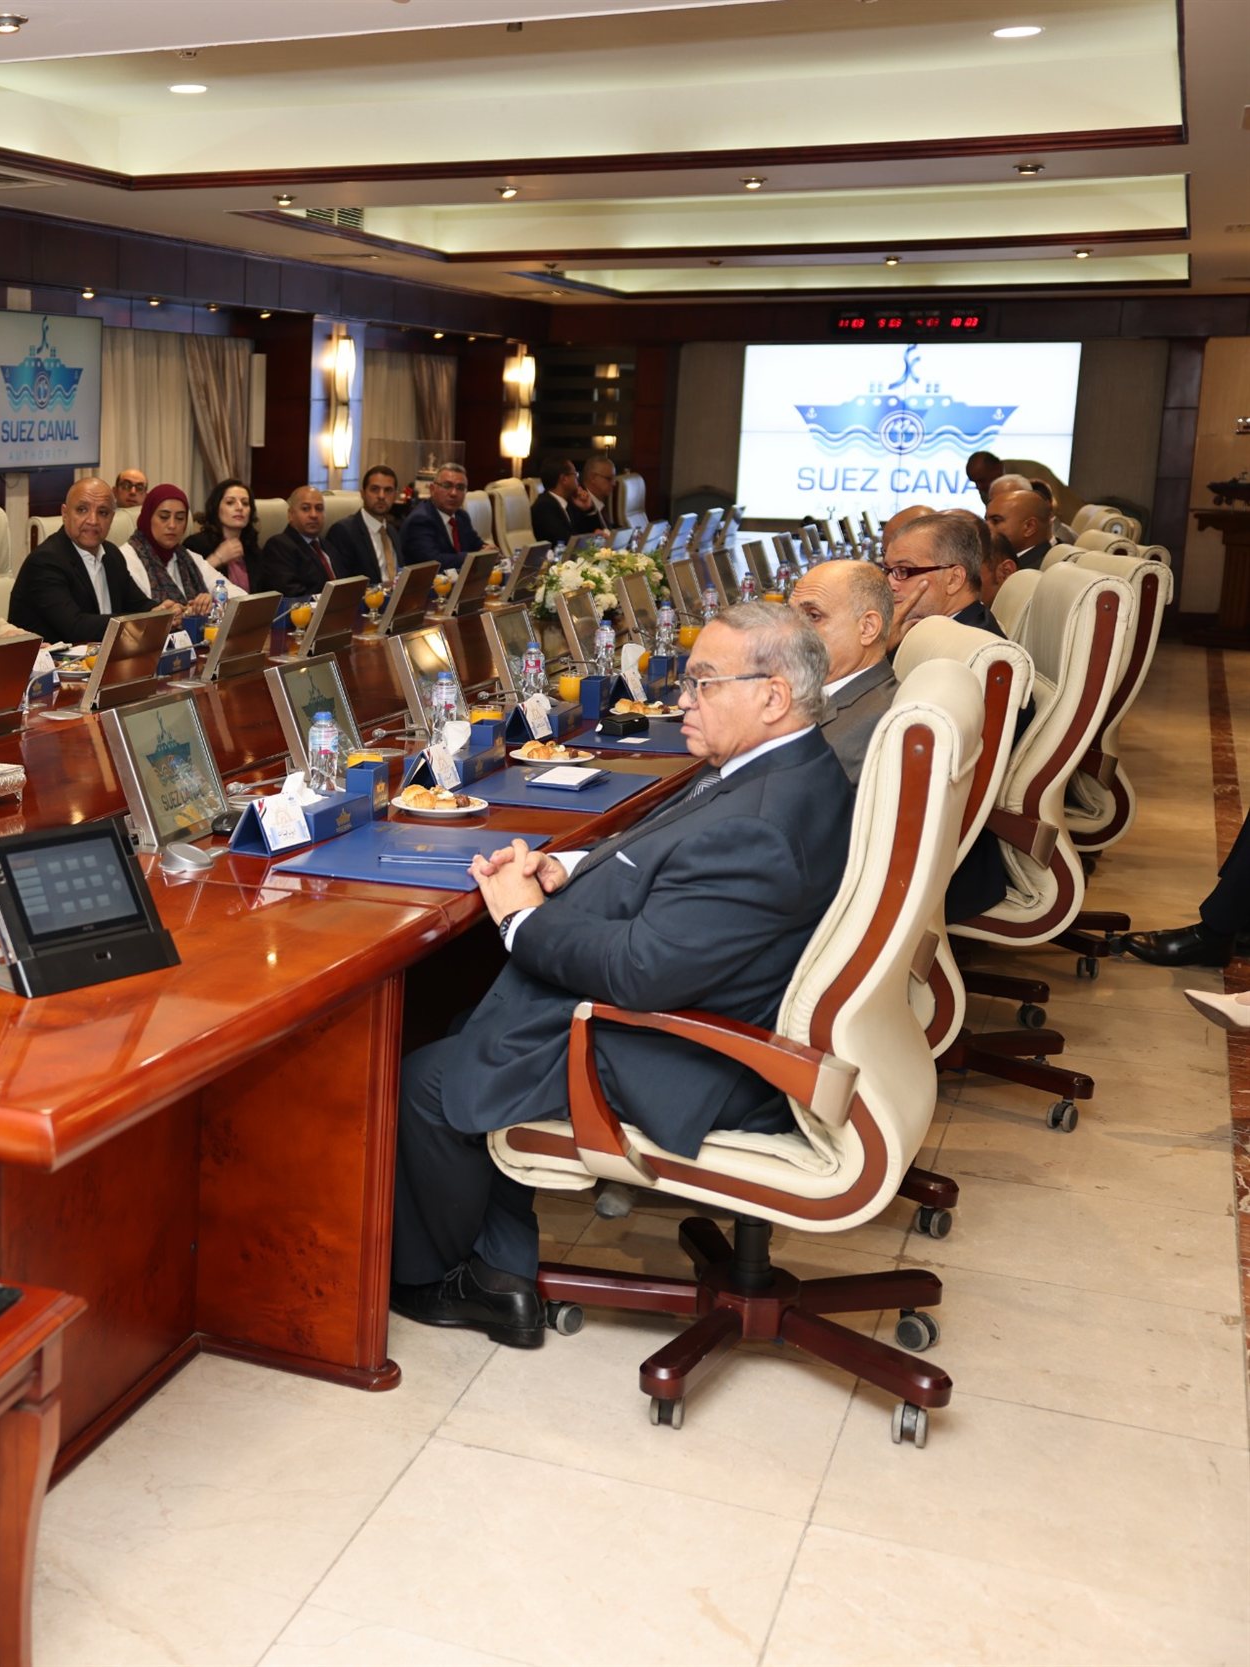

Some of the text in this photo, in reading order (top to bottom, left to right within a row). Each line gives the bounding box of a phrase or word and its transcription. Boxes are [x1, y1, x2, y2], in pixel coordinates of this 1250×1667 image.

[1, 419, 79, 443] SUEZ CANAL
[797, 467, 879, 492] SUEZ
[160, 790, 182, 812] SUEZ
